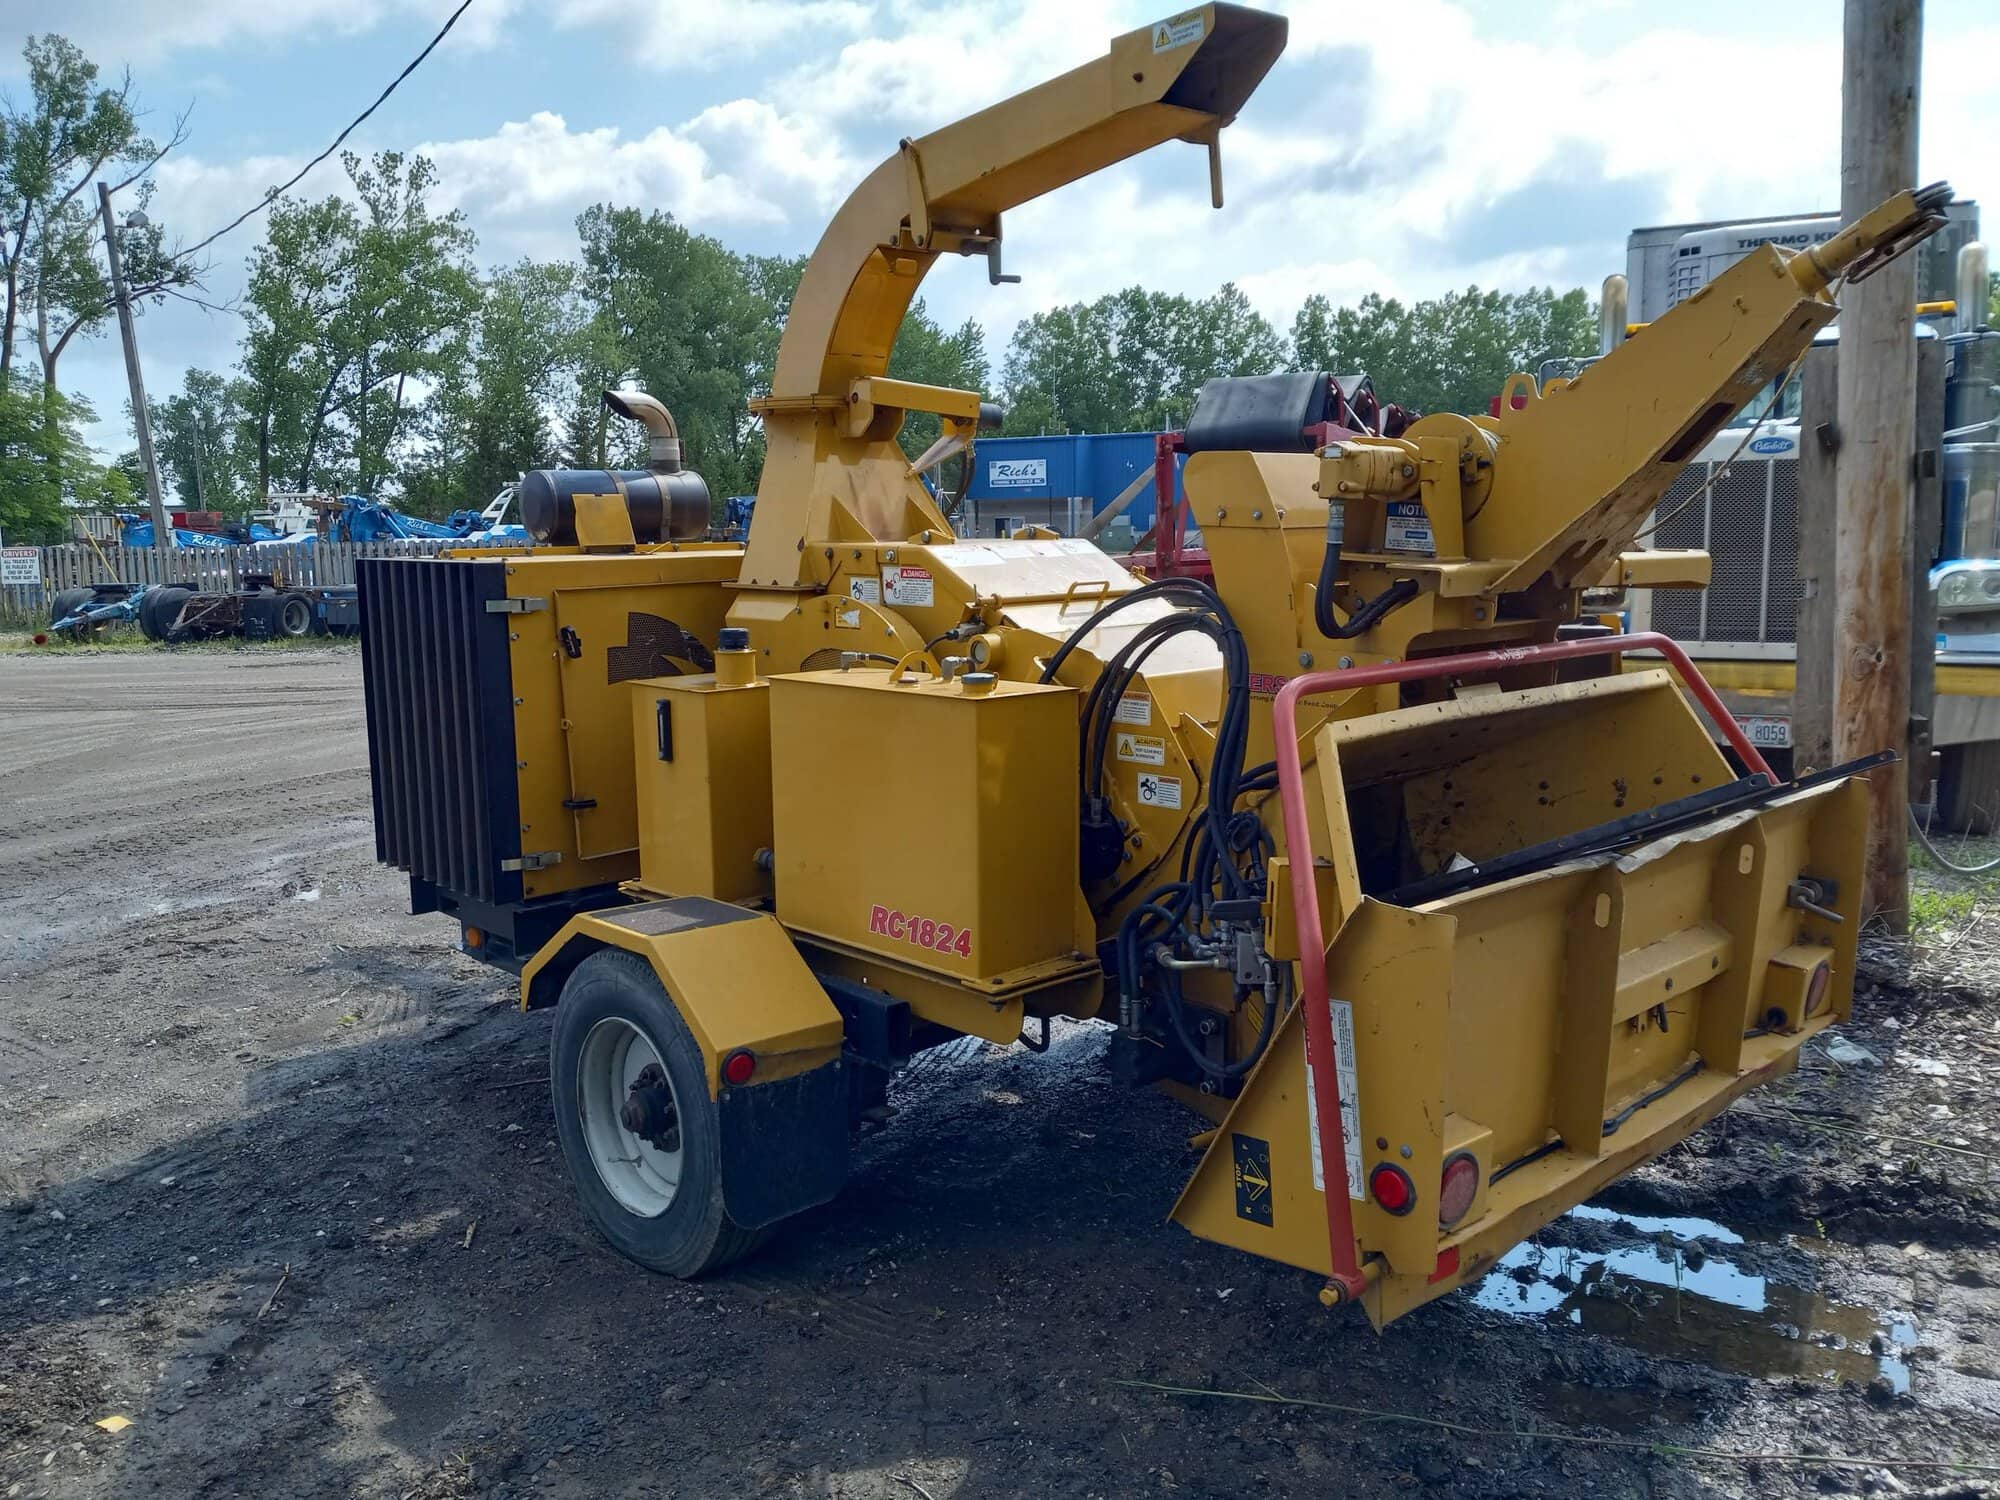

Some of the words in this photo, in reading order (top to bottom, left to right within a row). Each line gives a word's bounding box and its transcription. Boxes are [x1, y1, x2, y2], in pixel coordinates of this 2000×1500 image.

[1398, 504, 1424, 516] NOTI
[3, 550, 36, 558] DRIVERS!
[1755, 725, 1786, 741] 8059
[869, 904, 972, 959] RC1824
